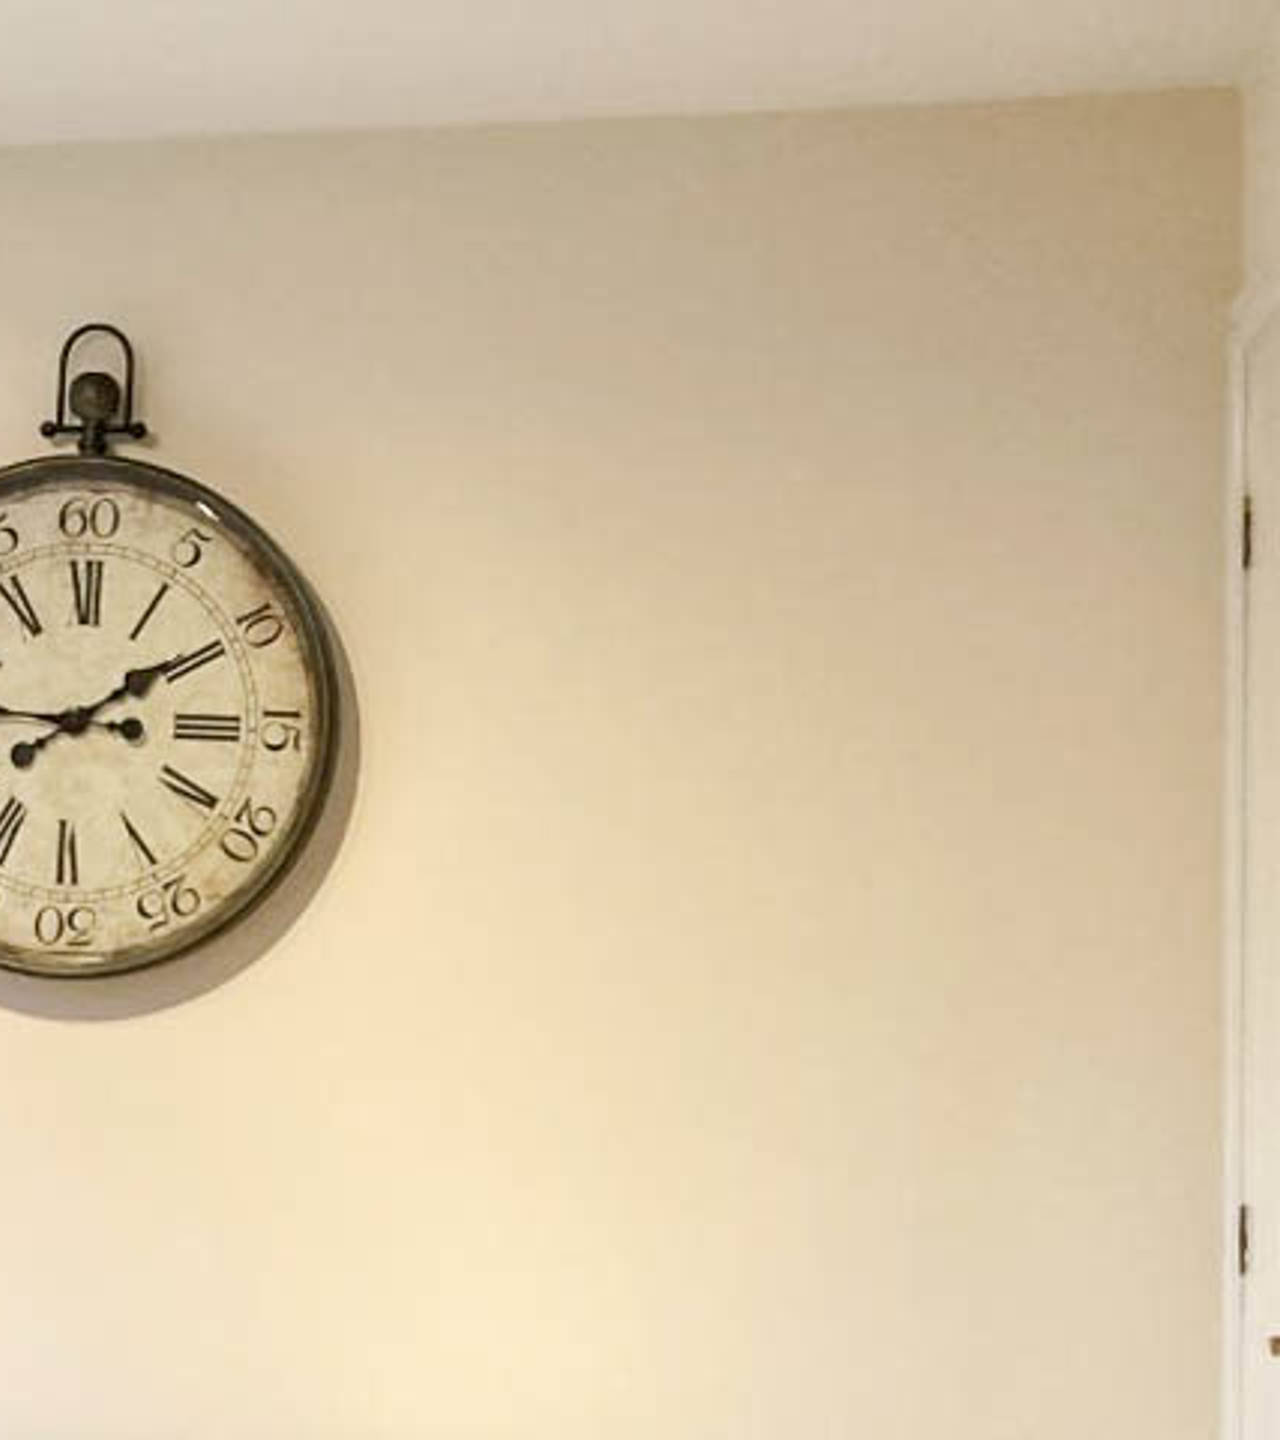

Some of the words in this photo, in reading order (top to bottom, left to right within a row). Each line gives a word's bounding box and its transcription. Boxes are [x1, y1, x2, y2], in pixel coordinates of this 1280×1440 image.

[59, 497, 121, 538] 60
[170, 526, 215, 569] 5
[235, 601, 285, 650] 10
[261, 707, 301, 752] 15
[220, 798, 278, 863] 20
[34, 905, 97, 947] 30
[136, 879, 201, 930] 25
